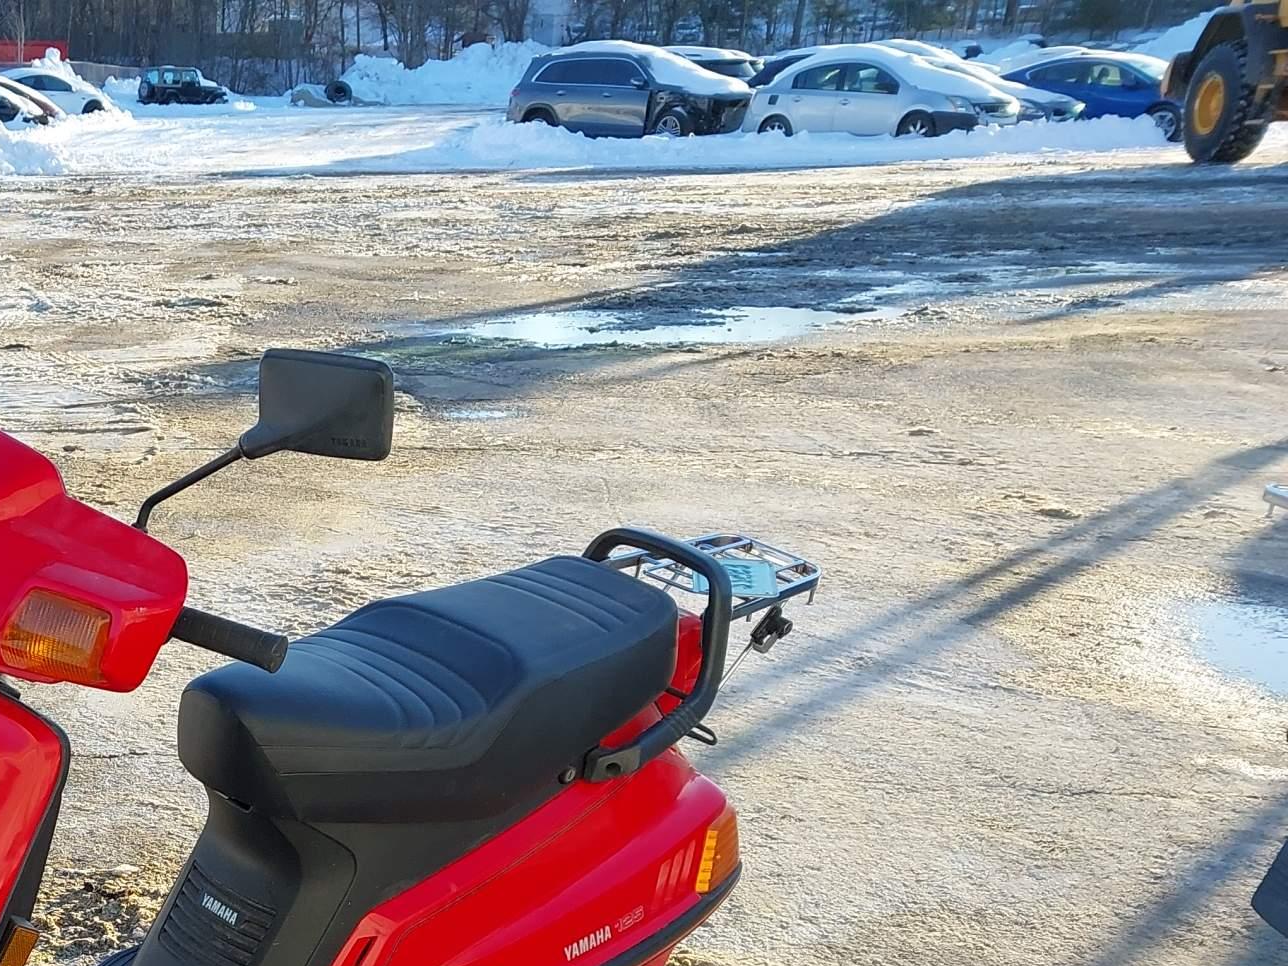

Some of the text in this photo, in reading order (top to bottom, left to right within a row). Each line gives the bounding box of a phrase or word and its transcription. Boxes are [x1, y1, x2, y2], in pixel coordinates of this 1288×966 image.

[201, 892, 239, 926] YAMAHA
[563, 905, 645, 962] YAMAHA 125
